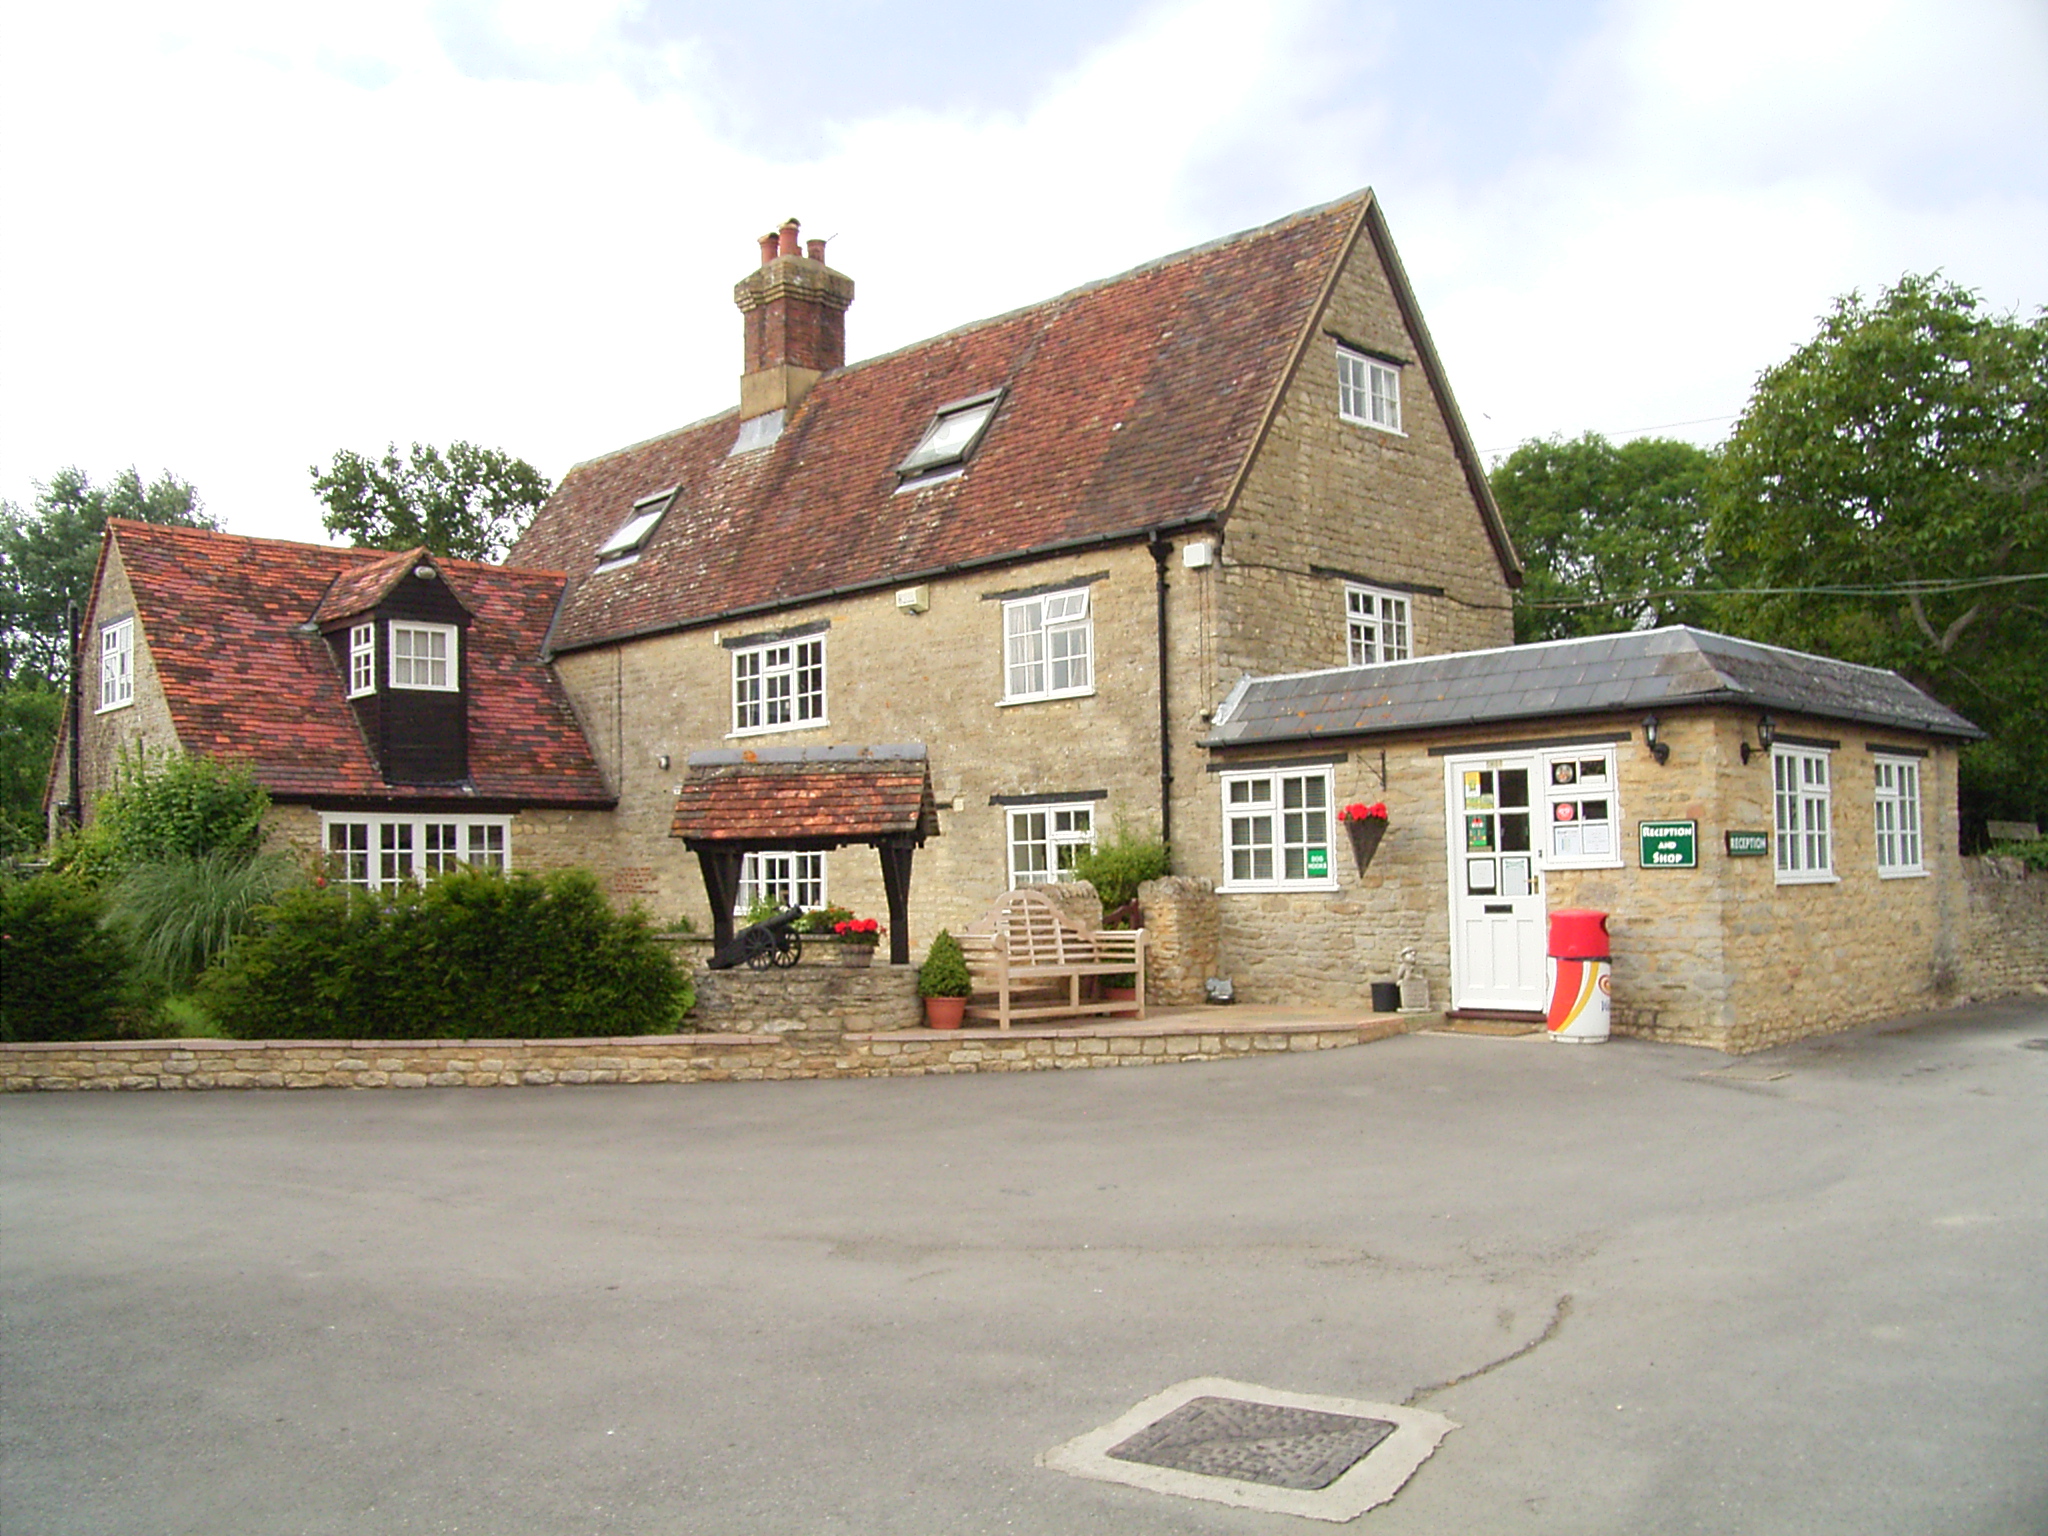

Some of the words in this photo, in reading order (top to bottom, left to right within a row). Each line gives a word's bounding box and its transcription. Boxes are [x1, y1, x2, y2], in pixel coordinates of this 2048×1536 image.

[1642, 826, 1692, 837] RECEPTION
[1657, 841, 1677, 850] AND
[1729, 837, 1766, 849] RECEPTION
[1652, 852, 1683, 864] SHOP
